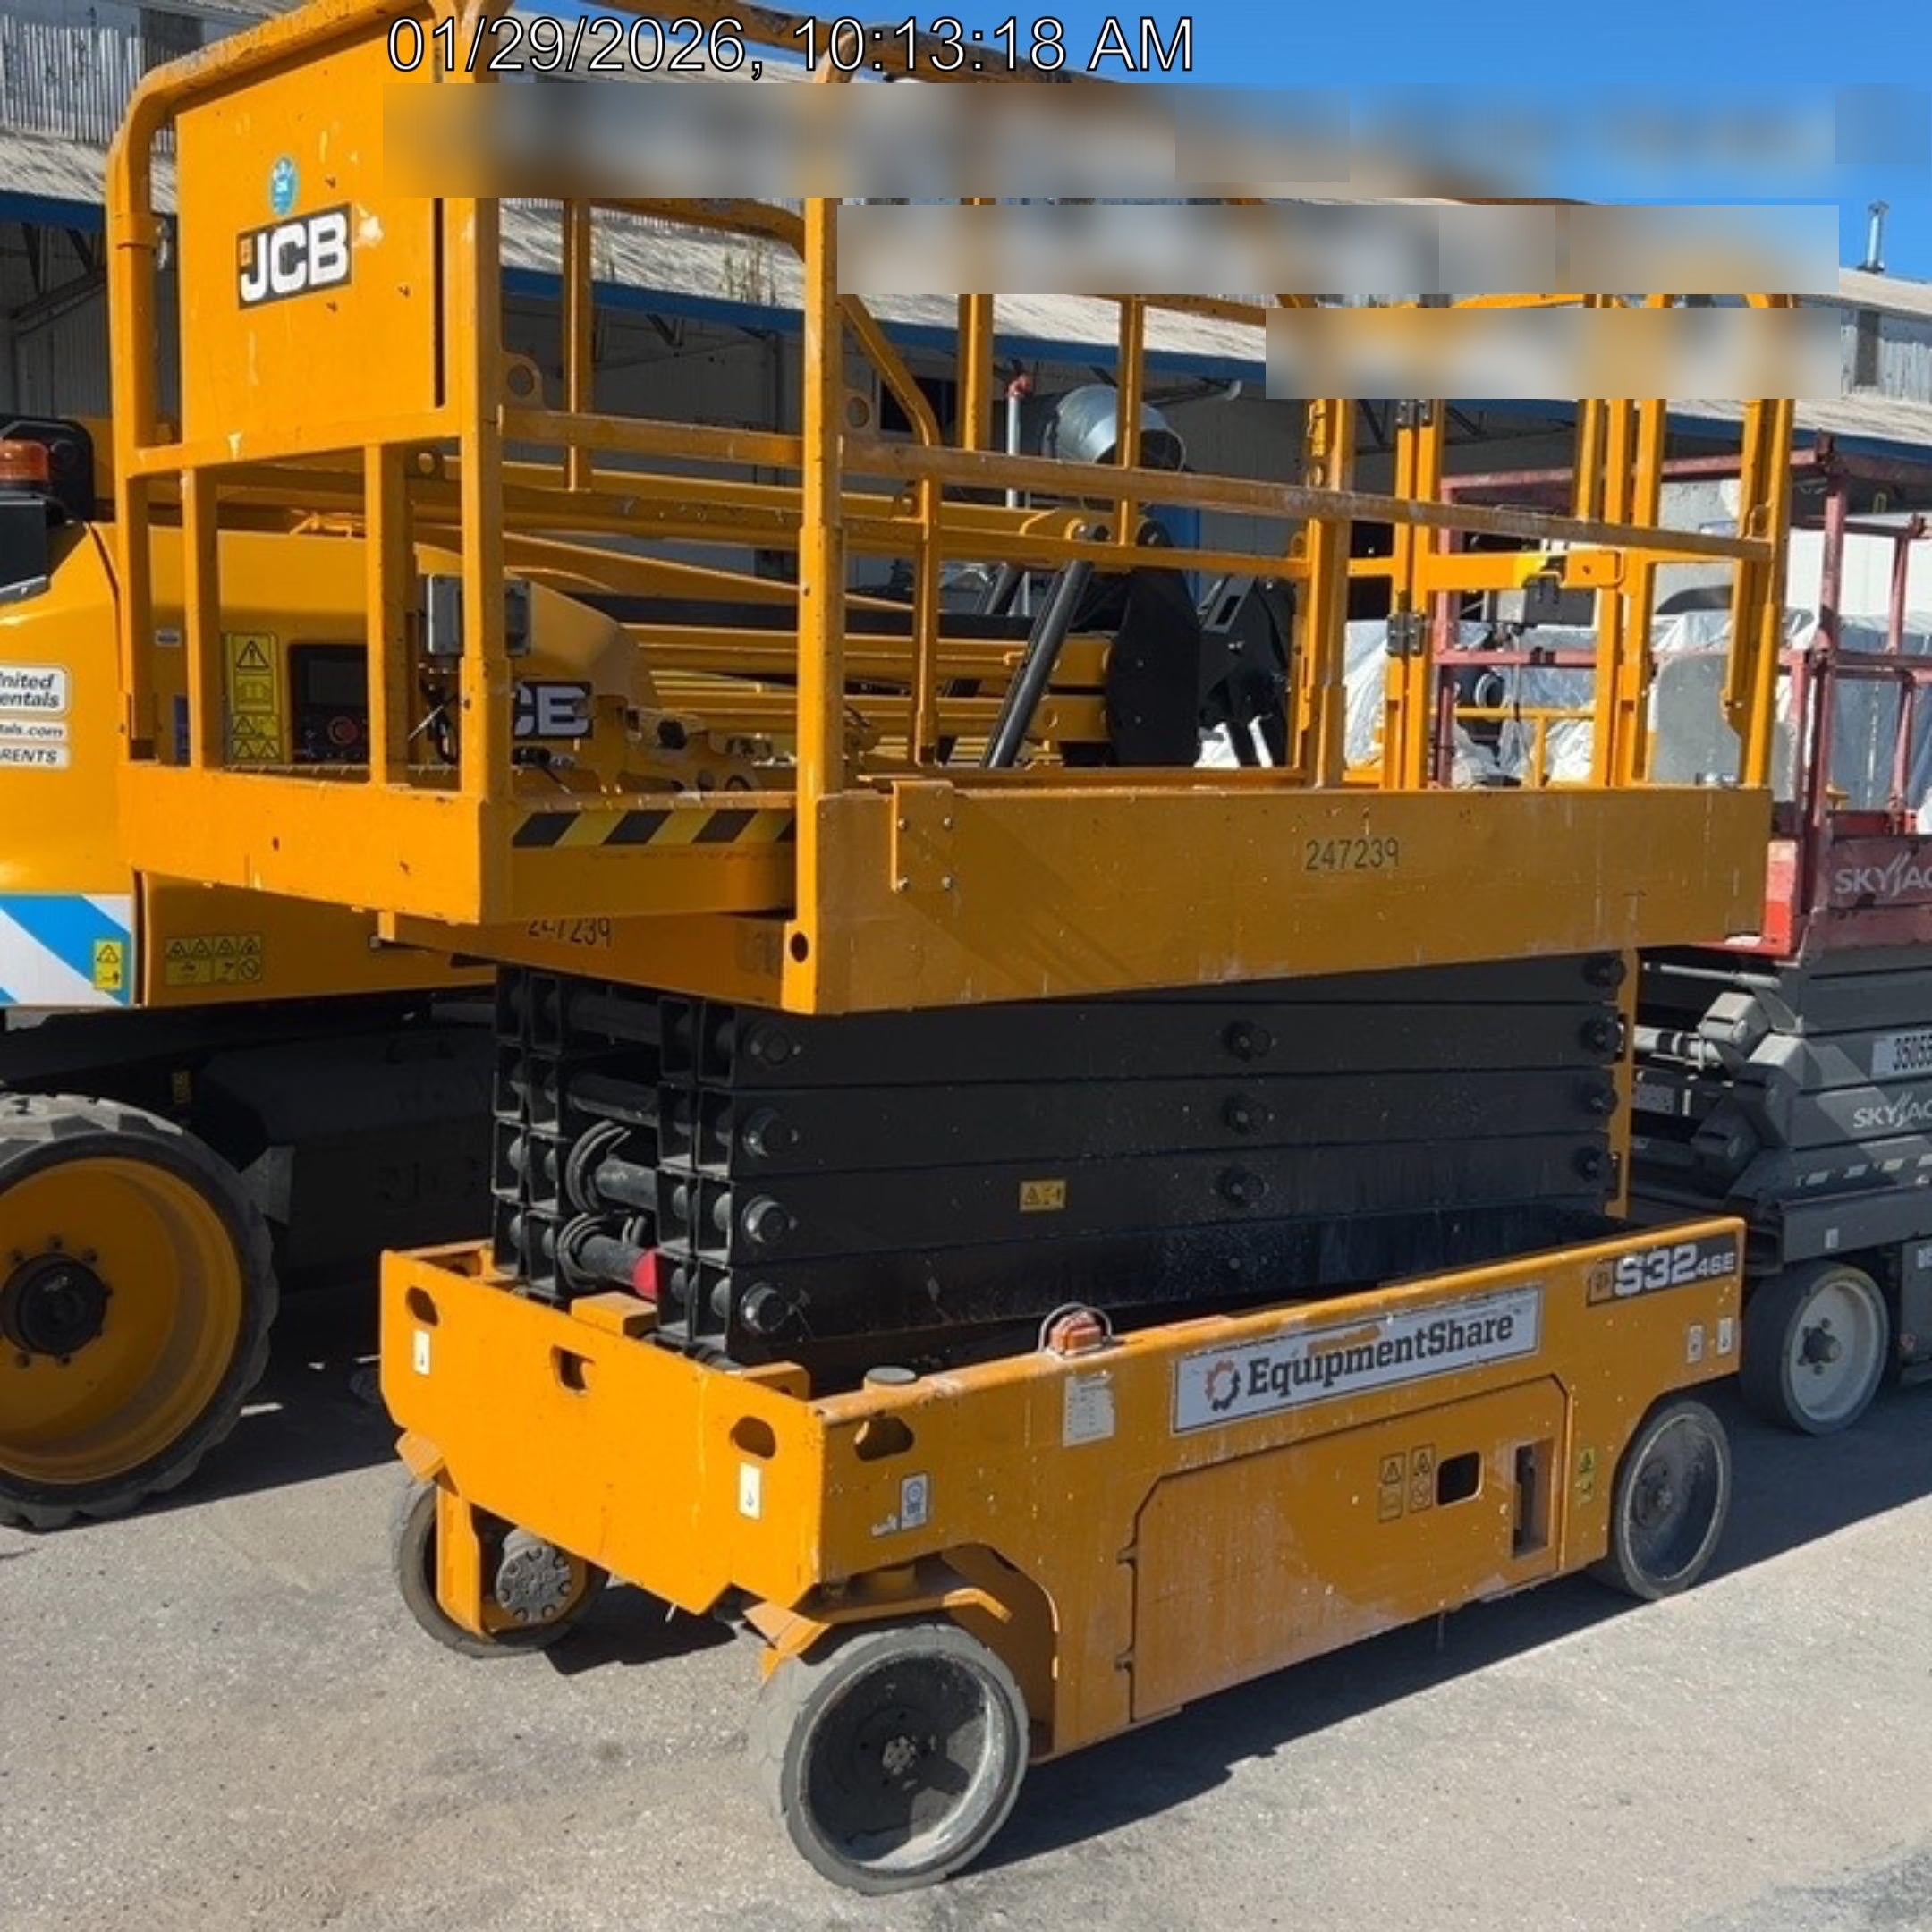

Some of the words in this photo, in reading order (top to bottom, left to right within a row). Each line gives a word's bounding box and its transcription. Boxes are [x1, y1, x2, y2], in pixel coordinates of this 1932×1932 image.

[241, 213, 349, 301] JCB
[0, 672, 54, 691] nited
[0, 692, 60, 708] entals
[1305, 837, 1400, 870] 247239
[1247, 1314, 1514, 1398] EquipmentShare
